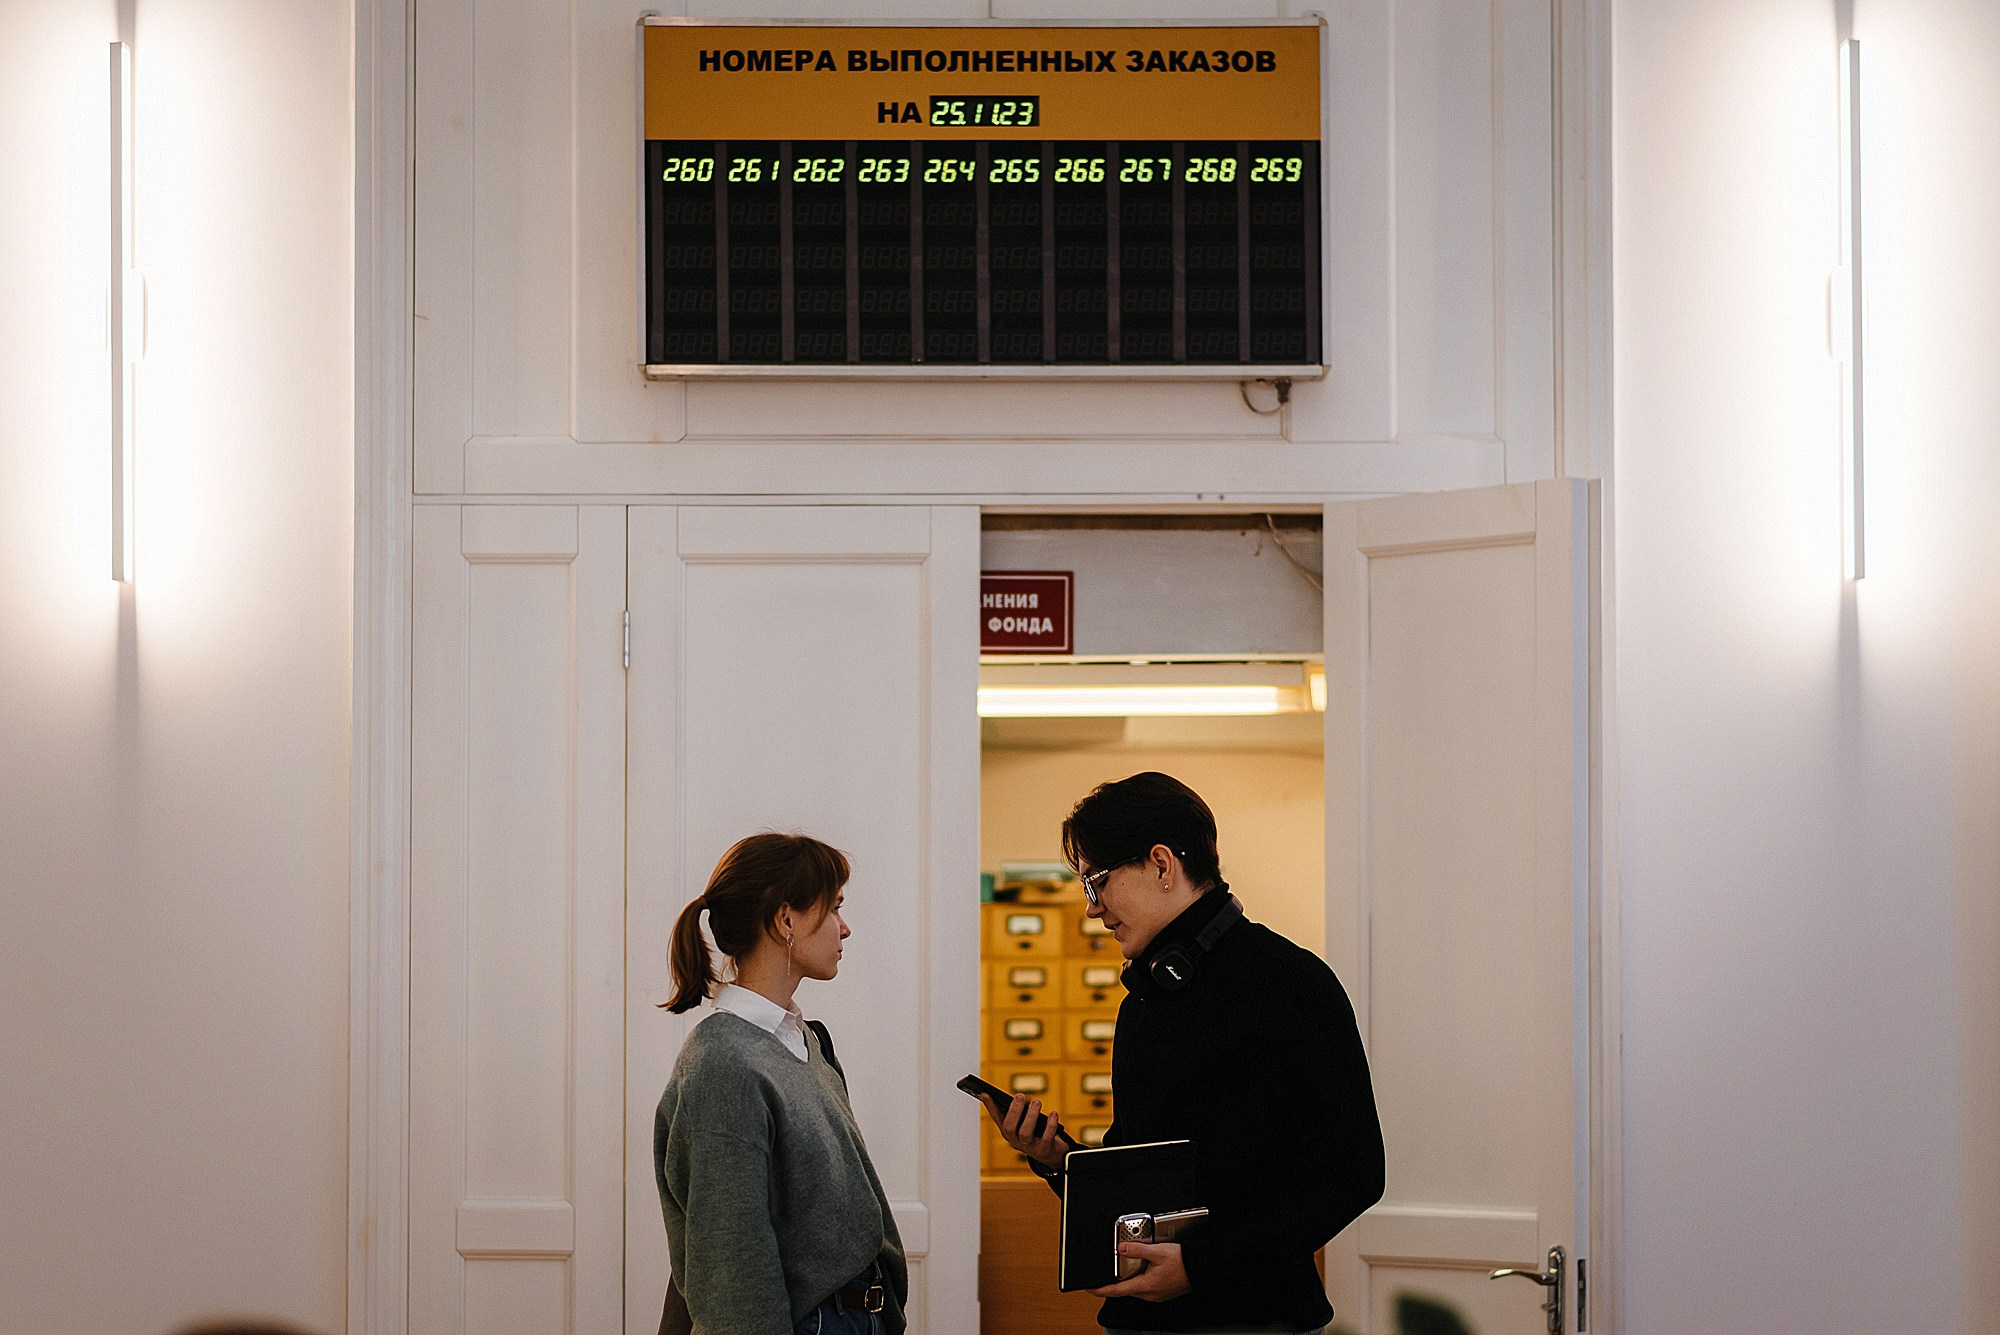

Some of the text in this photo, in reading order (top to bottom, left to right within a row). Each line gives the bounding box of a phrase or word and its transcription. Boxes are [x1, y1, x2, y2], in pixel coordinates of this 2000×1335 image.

[699, 49, 1277, 73] НОМЕРА ВЫПОЛНЕННЫХ ЗАКАЗОВ
[877, 101, 1034, 125] НА 25.11.23
[662, 157, 1303, 183] 260 261 262 263 264 265 266 267 268 269
[980, 593, 1039, 609] НЕНИЯ
[987, 616, 1054, 635] ФОНДА
